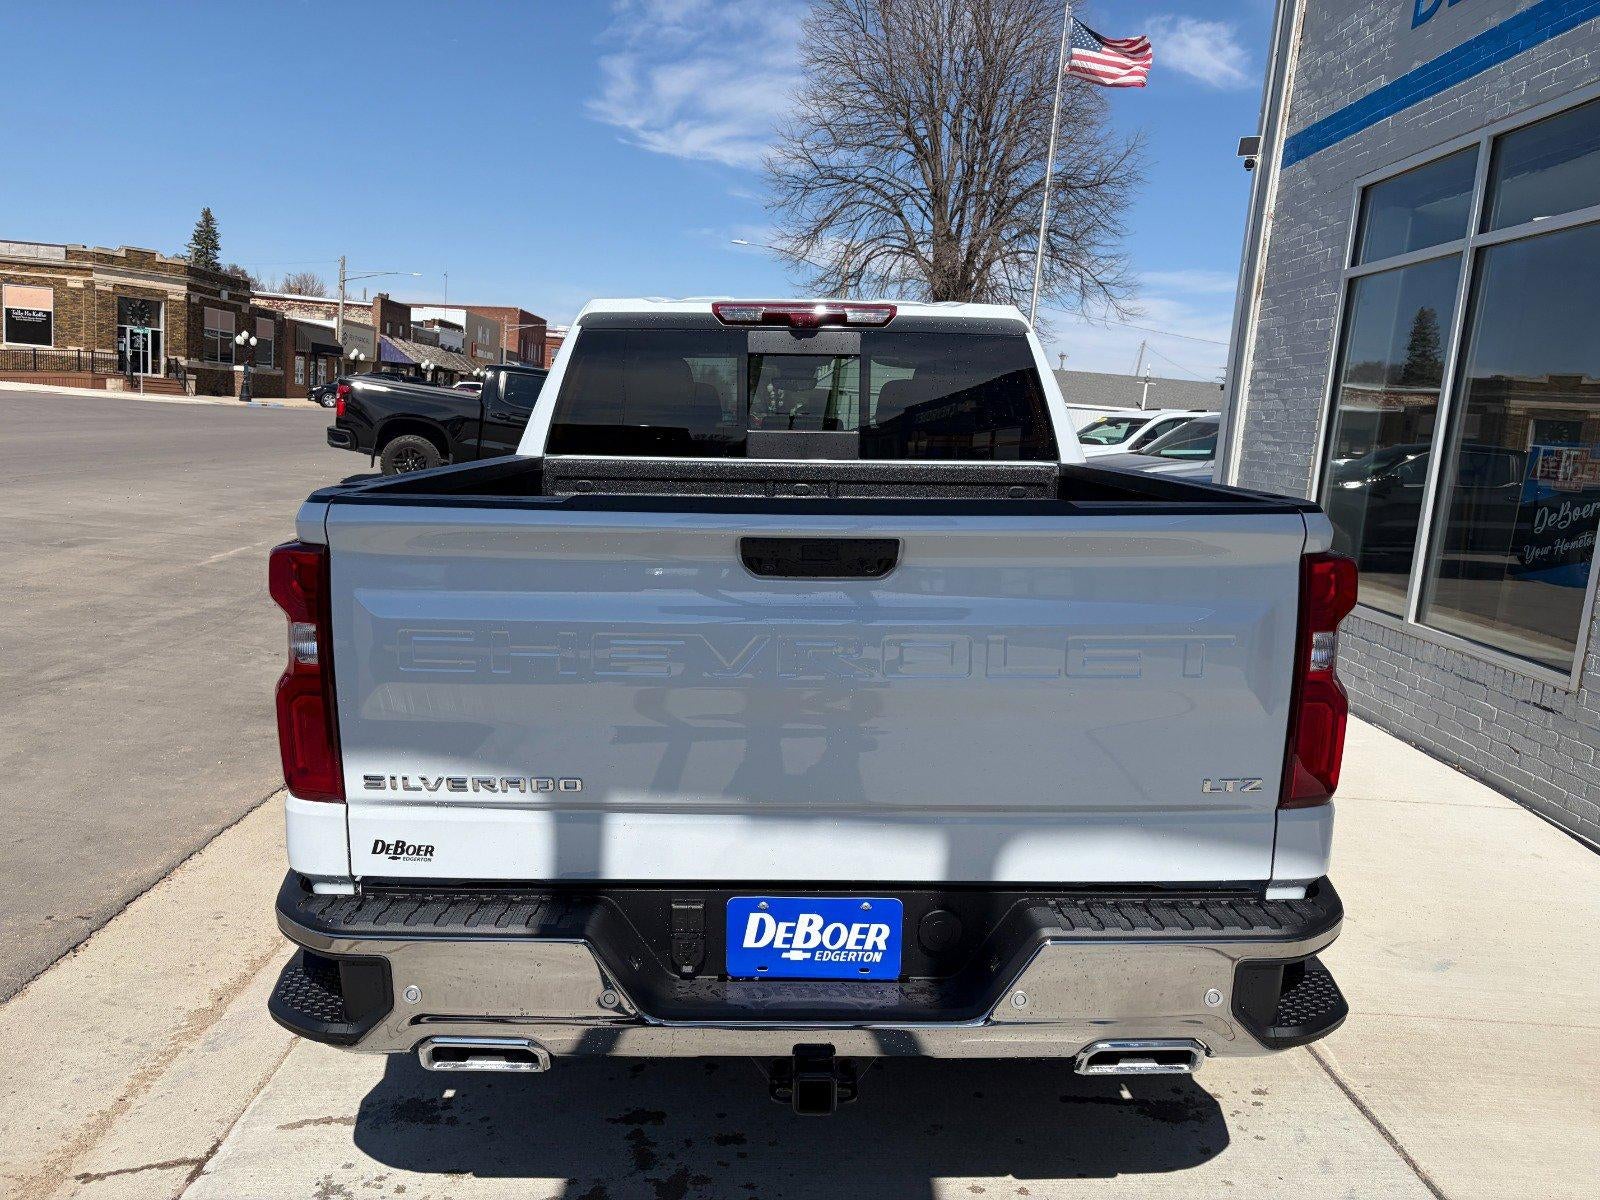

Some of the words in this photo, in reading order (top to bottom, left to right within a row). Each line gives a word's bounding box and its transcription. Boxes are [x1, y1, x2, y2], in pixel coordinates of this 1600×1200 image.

[1524, 543, 1552, 565] Your
[1553, 531, 1597, 555] Hometo
[396, 627, 1237, 679] CHEVROLET
[363, 774, 584, 794] SILVERADO
[1202, 777, 1264, 794] LTZ
[371, 839, 435, 857] DEBOER
[742, 912, 891, 951] DEBOER
[814, 950, 883, 963] EDGERTON
